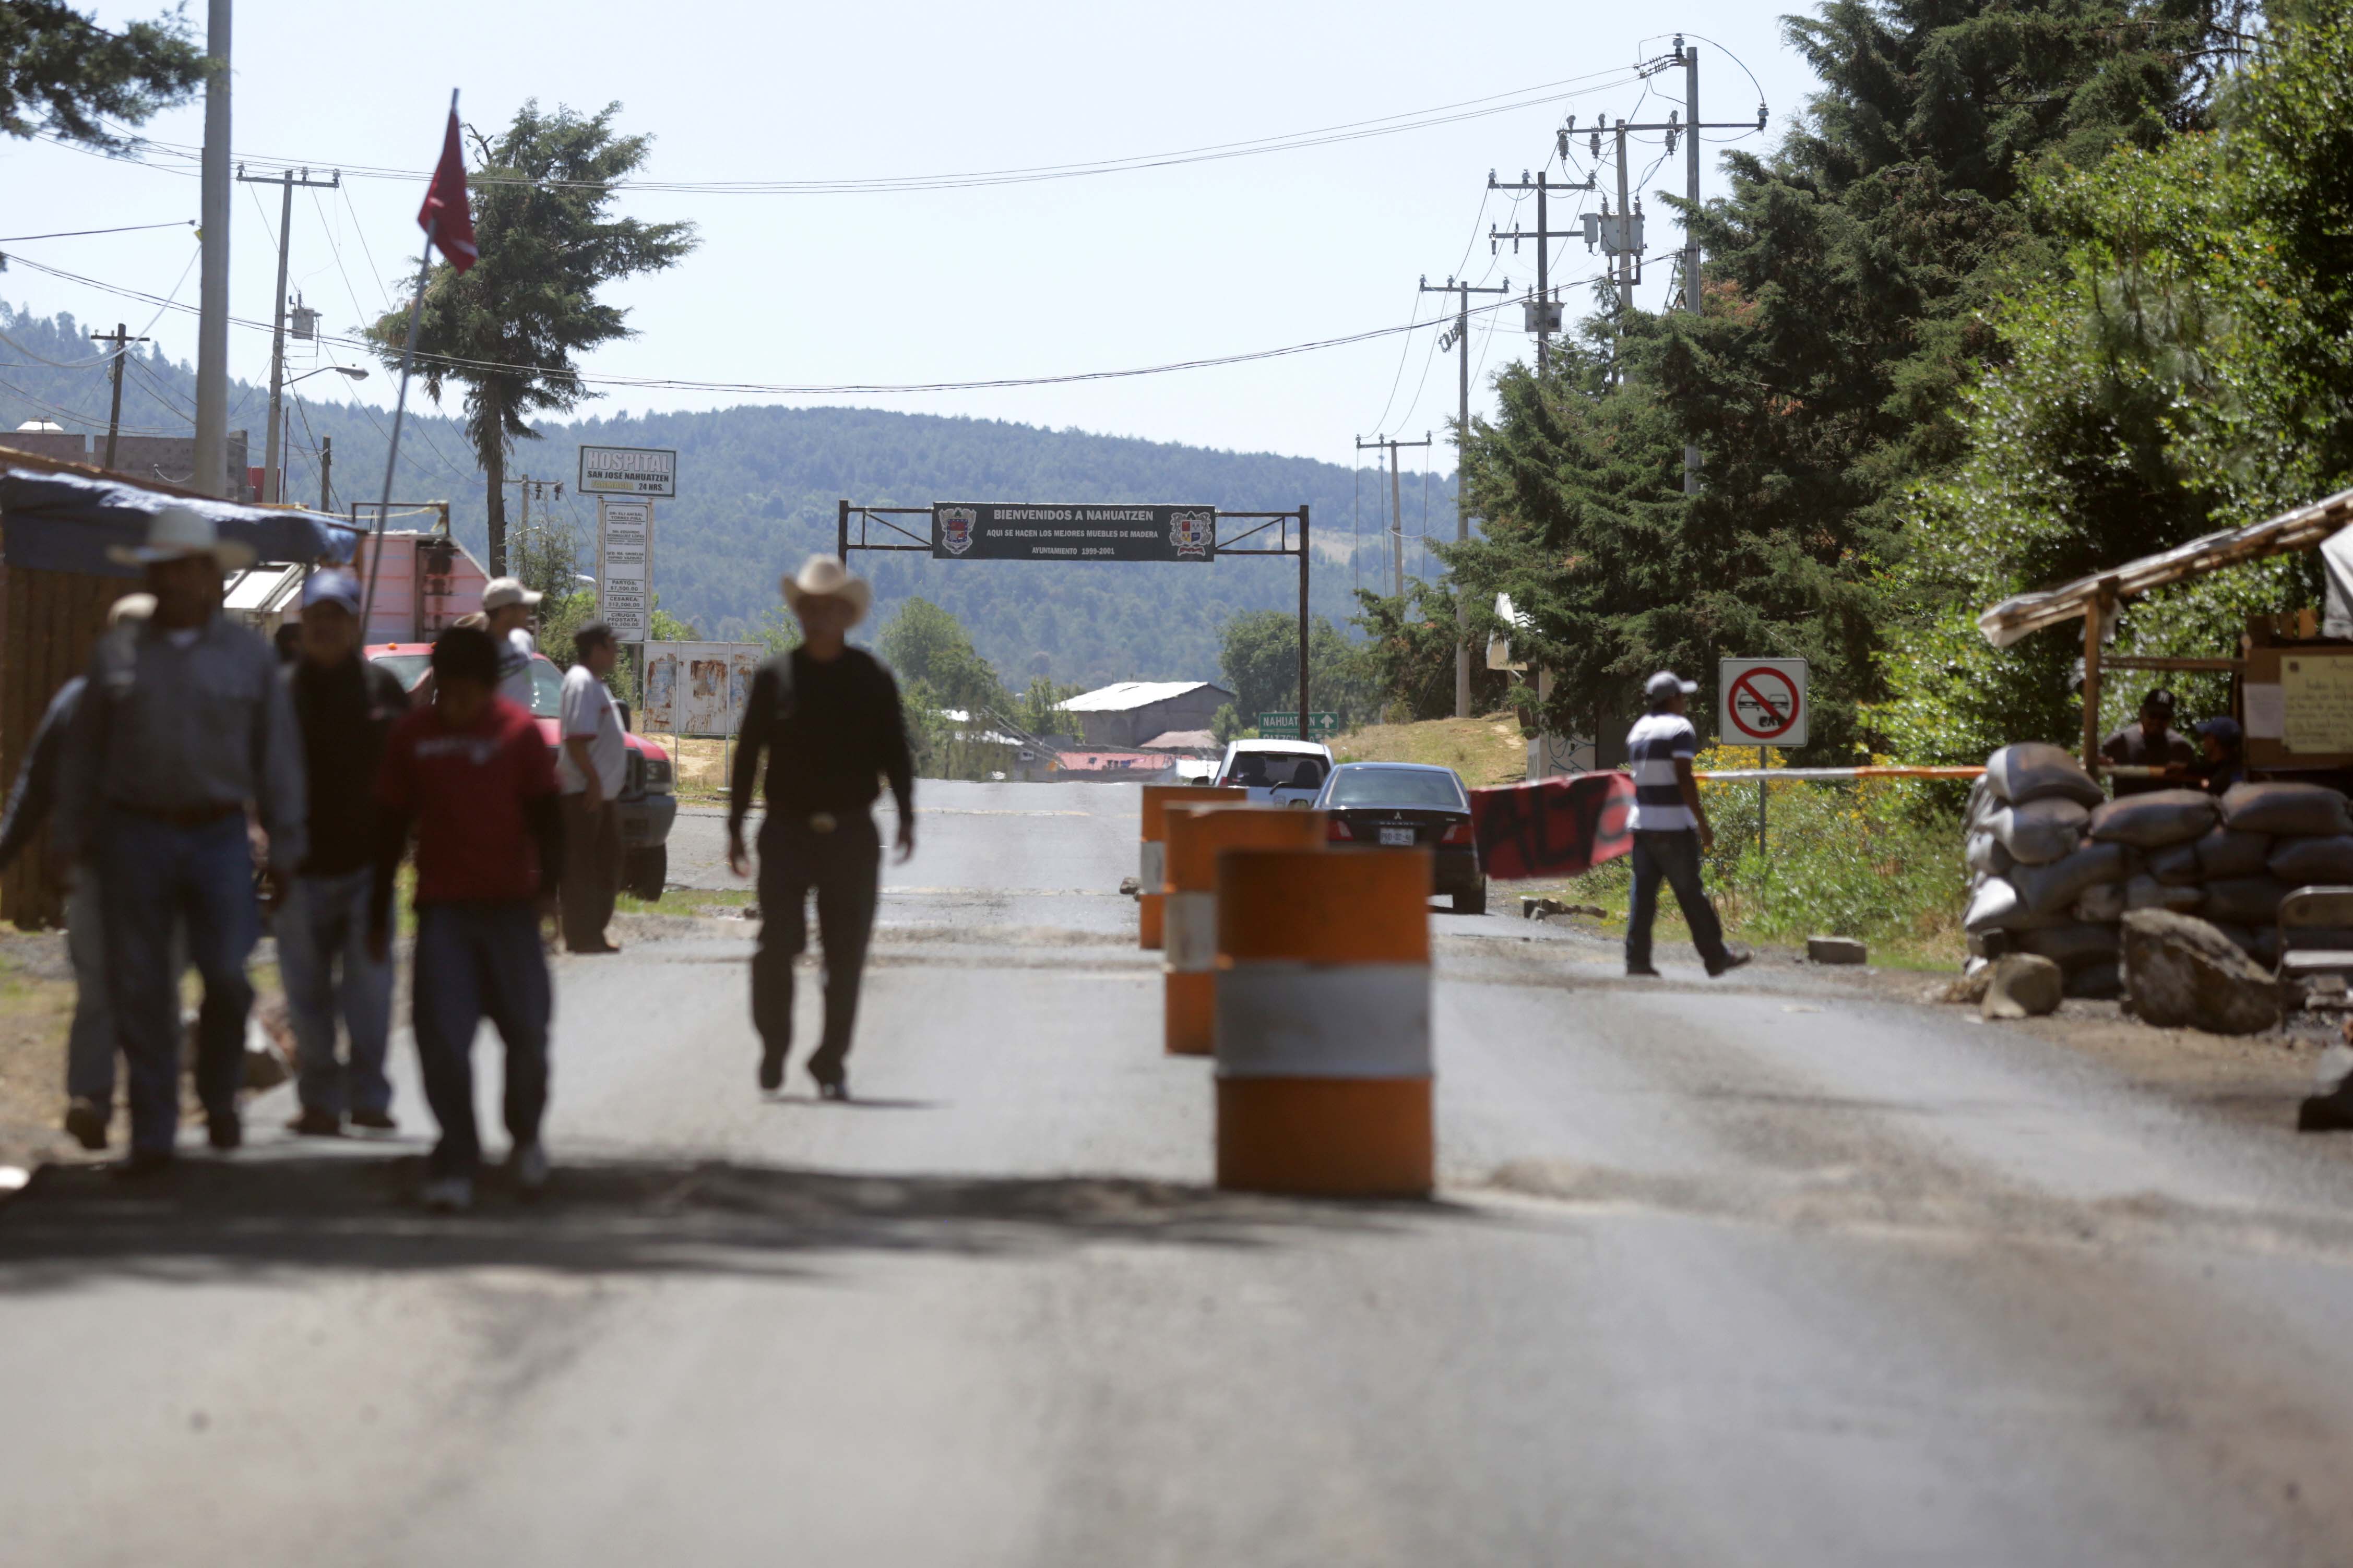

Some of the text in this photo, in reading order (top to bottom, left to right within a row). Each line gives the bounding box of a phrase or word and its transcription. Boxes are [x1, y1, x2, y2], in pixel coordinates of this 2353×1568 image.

[588, 451, 670, 473] HOSPITAL
[604, 471, 622, 480] JOSÉ
[624, 472, 669, 482] NAHUATZEN
[994, 510, 1154, 521] BIENVENIDOS A NAHUATZEN
[1264, 716, 1315, 727] NAHUATN
